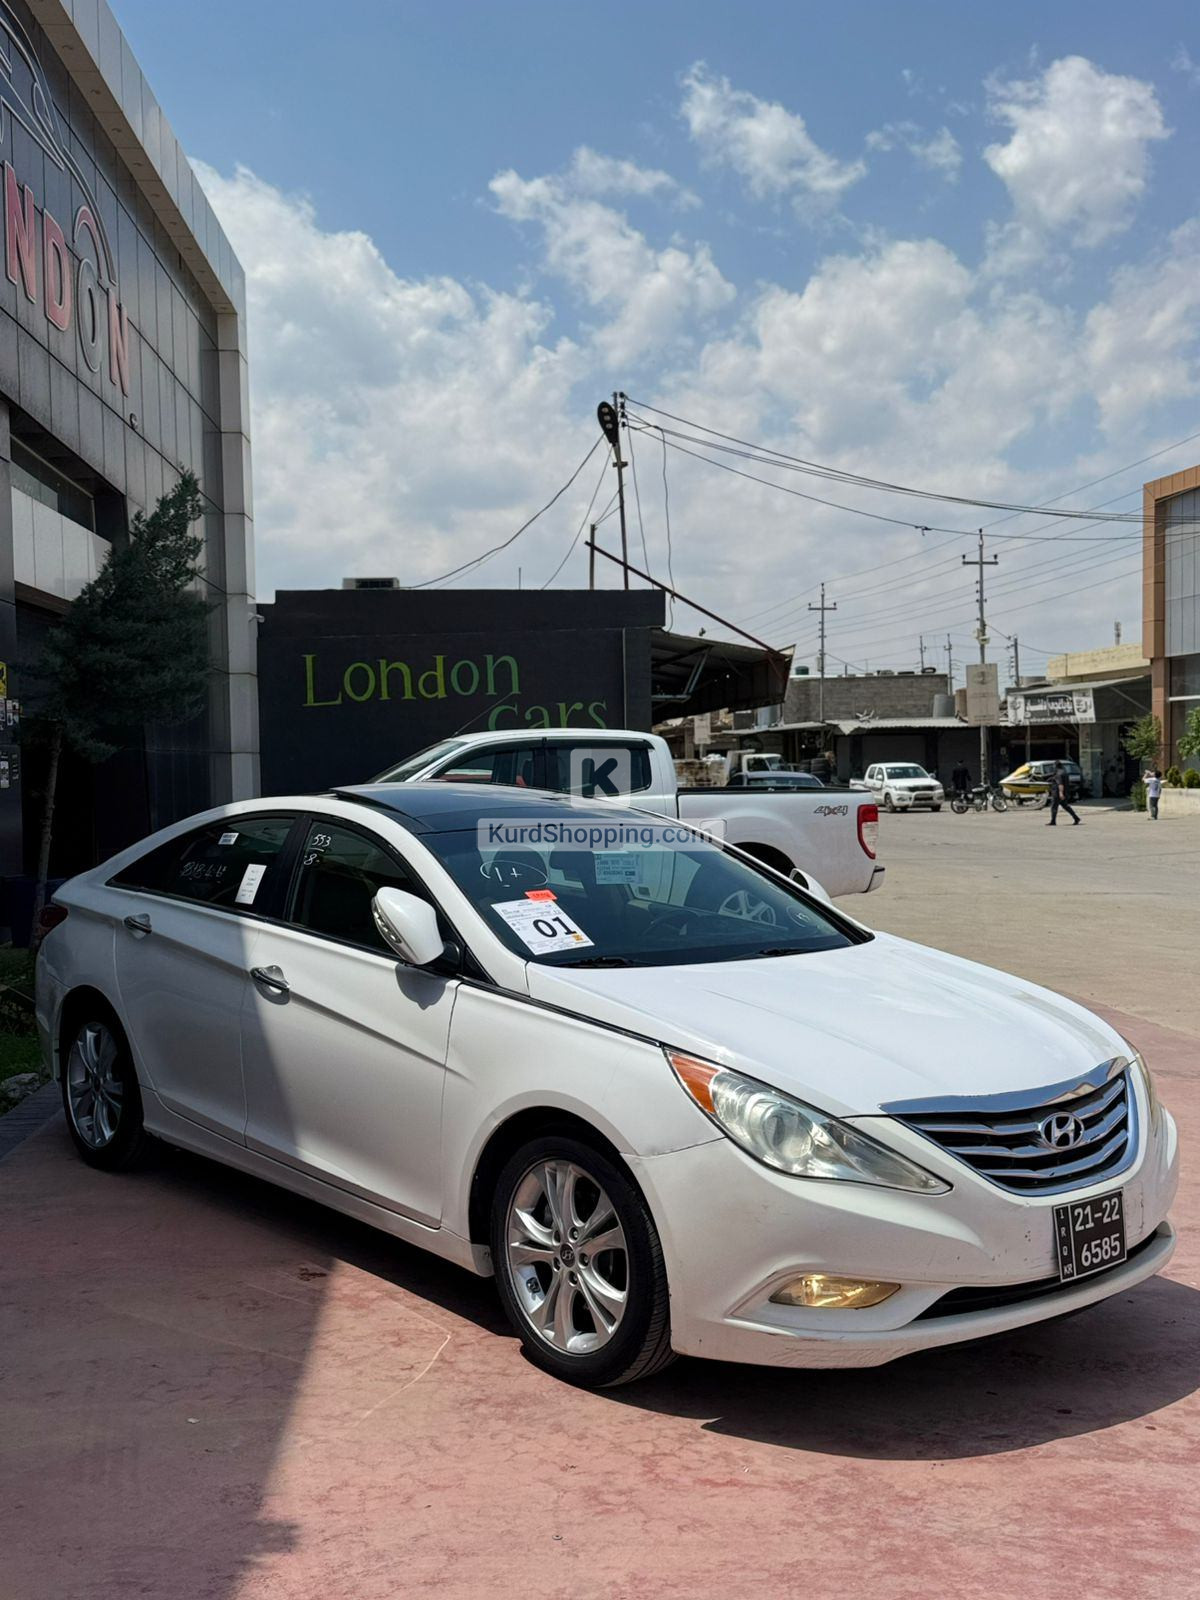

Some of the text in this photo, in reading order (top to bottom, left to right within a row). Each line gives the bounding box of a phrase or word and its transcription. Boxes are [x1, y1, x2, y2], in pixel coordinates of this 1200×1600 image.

[302, 654, 521, 706] London
[312, 834, 331, 847] 553
[532, 916, 577, 938] 01
[1074, 1197, 1120, 1232] 21-22
[1081, 1233, 1121, 1267] 6585
